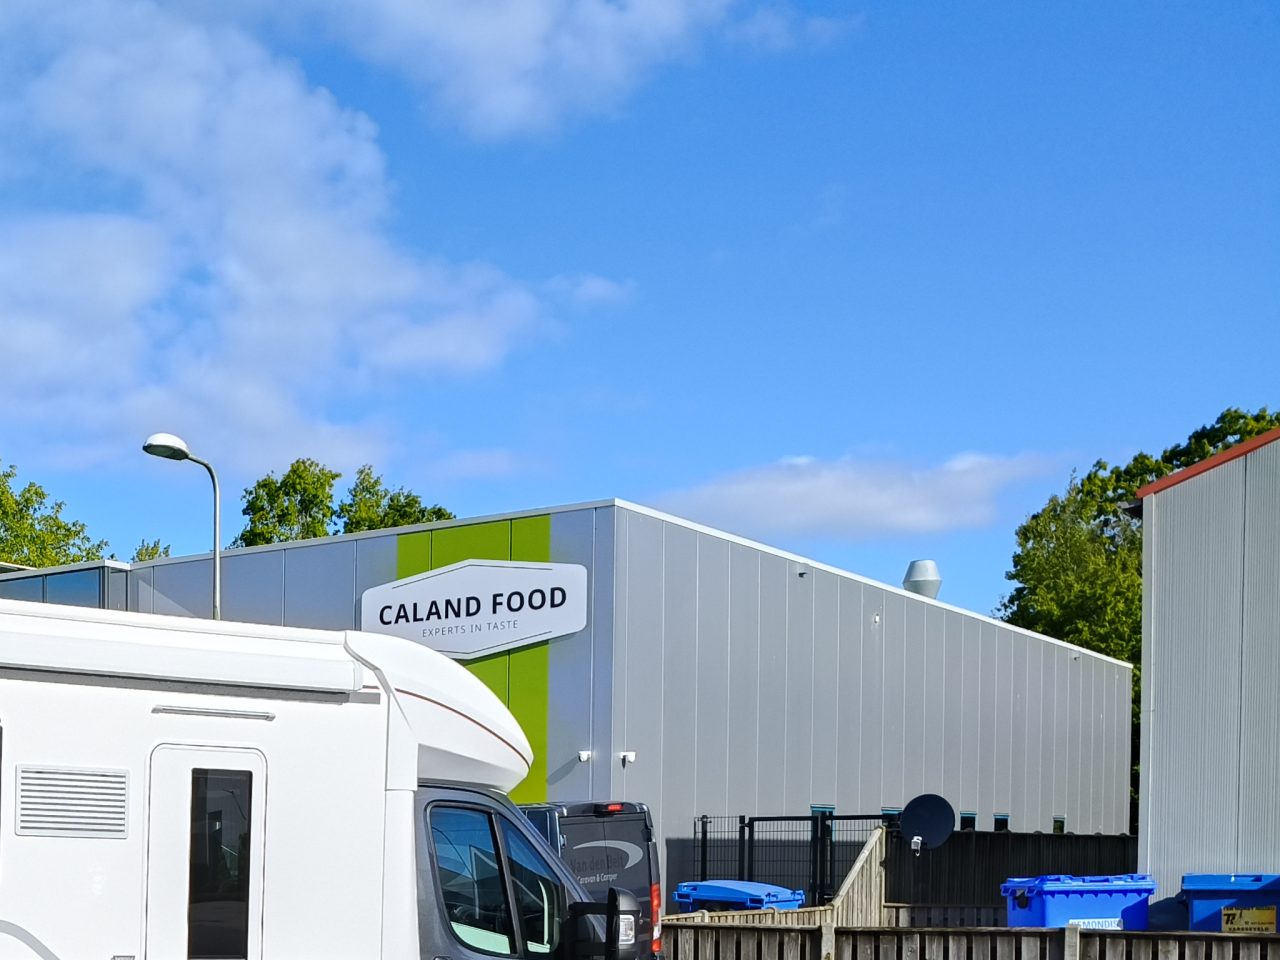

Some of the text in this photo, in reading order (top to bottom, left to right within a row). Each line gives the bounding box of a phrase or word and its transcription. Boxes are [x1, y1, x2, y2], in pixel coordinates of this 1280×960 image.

[378, 586, 568, 626] CALAND FOOD
[421, 619, 519, 638] EXPERTS IN TASTE
